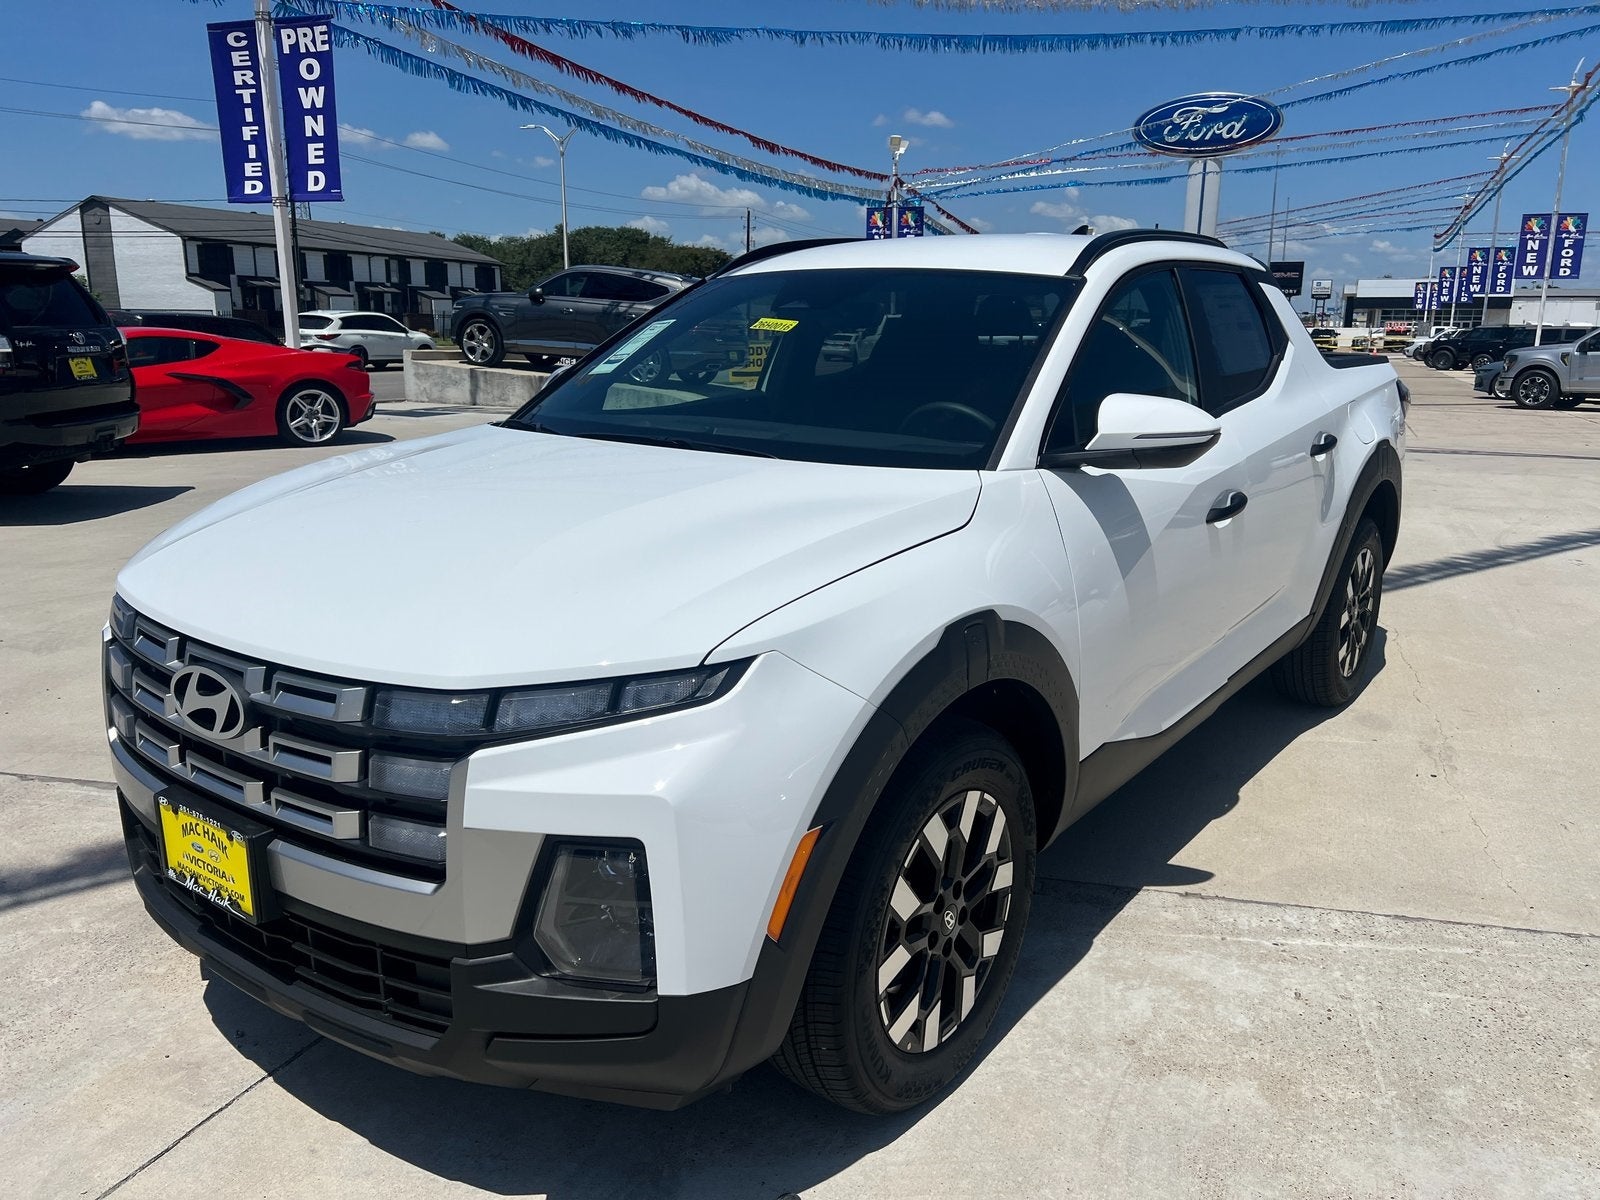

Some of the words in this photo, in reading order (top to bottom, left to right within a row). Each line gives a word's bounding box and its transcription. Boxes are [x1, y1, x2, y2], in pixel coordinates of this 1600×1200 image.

[280, 25, 330, 54] PRE
[226, 31, 264, 195] CERTIFIED
[297, 57, 326, 192] OWNED
[1163, 105, 1248, 142] Ford
[1522, 239, 1540, 276] NEW
[1558, 239, 1574, 276] FORD
[1440, 281, 1450, 302] NEW
[1469, 265, 1482, 292] NEW
[1496, 265, 1507, 292] FORD
[1415, 293, 1424, 309] NEW
[181, 821, 200, 838] MAC
[202, 825, 229, 859] HAIK
[188, 852, 227, 880] VICTORIA
[184, 876, 205, 891] Mac
